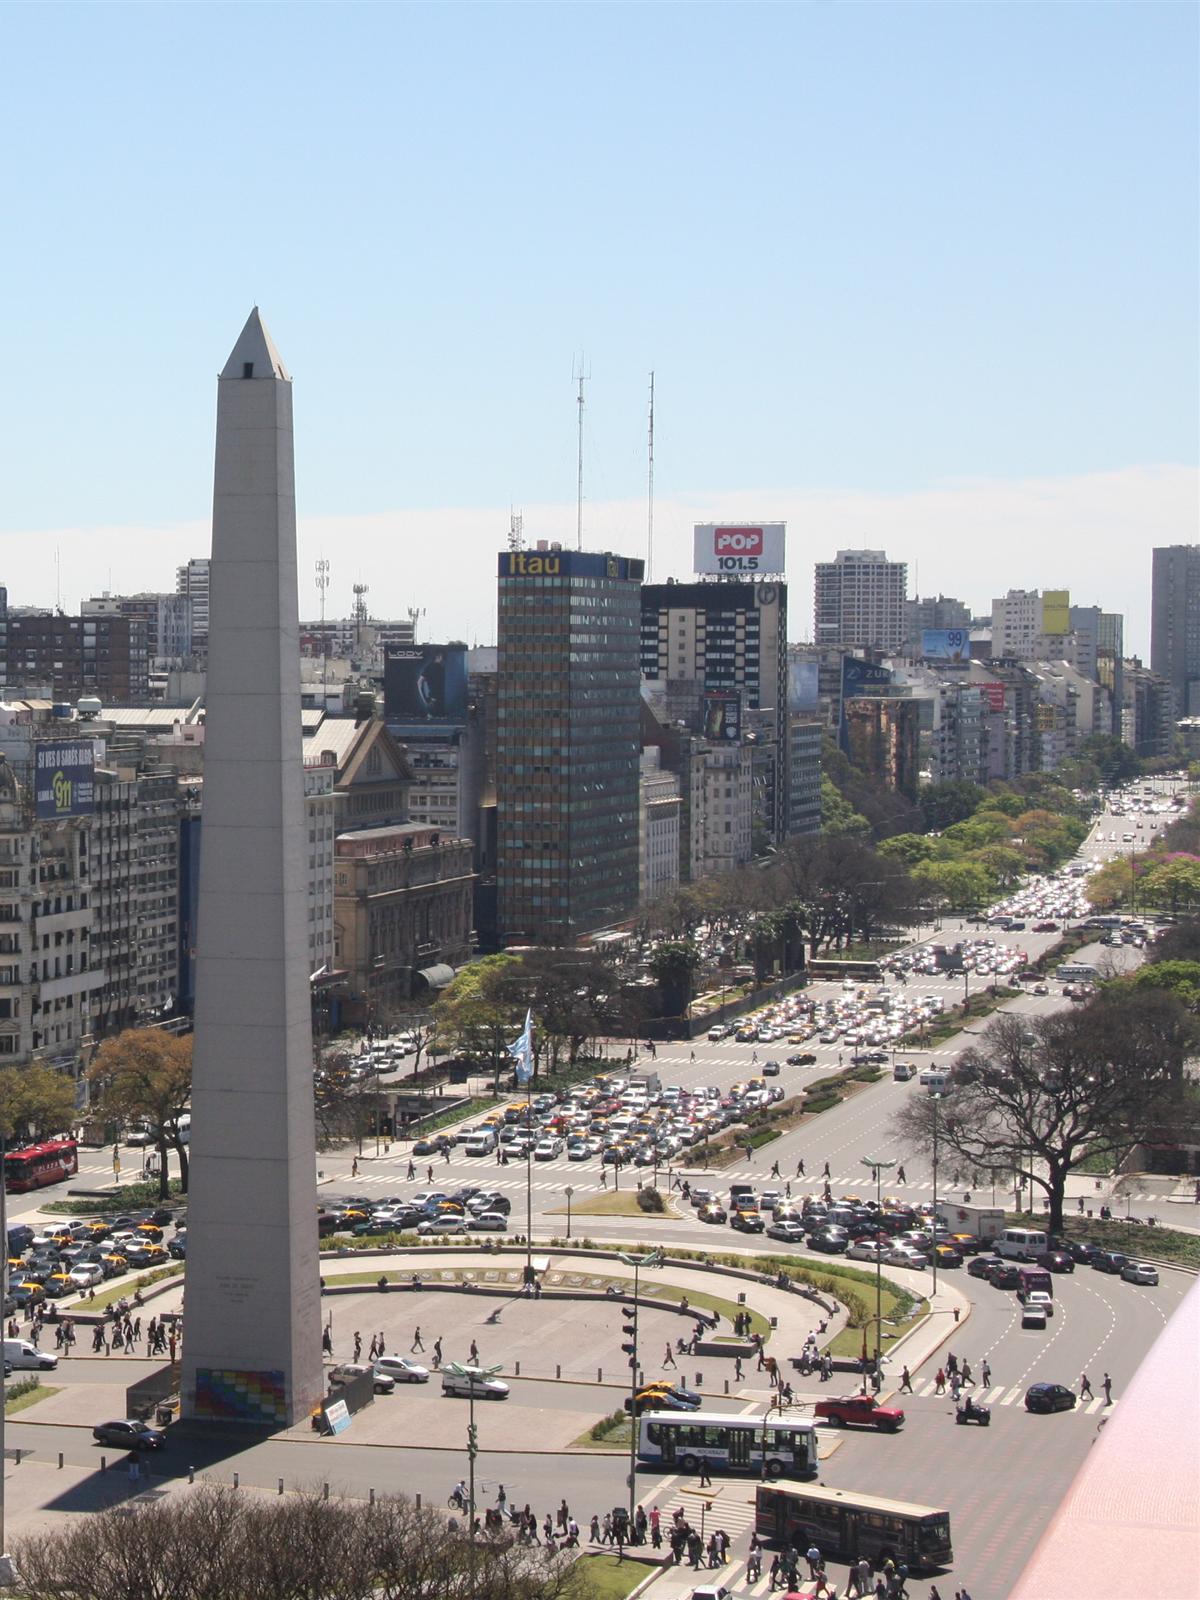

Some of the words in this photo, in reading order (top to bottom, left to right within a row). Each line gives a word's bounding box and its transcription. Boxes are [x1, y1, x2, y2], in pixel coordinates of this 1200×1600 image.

[718, 534, 760, 550] POP
[510, 554, 560, 574] Itaú
[718, 557, 759, 570] 101.5
[948, 632, 962, 647] 99
[55, 779, 72, 808] 911
